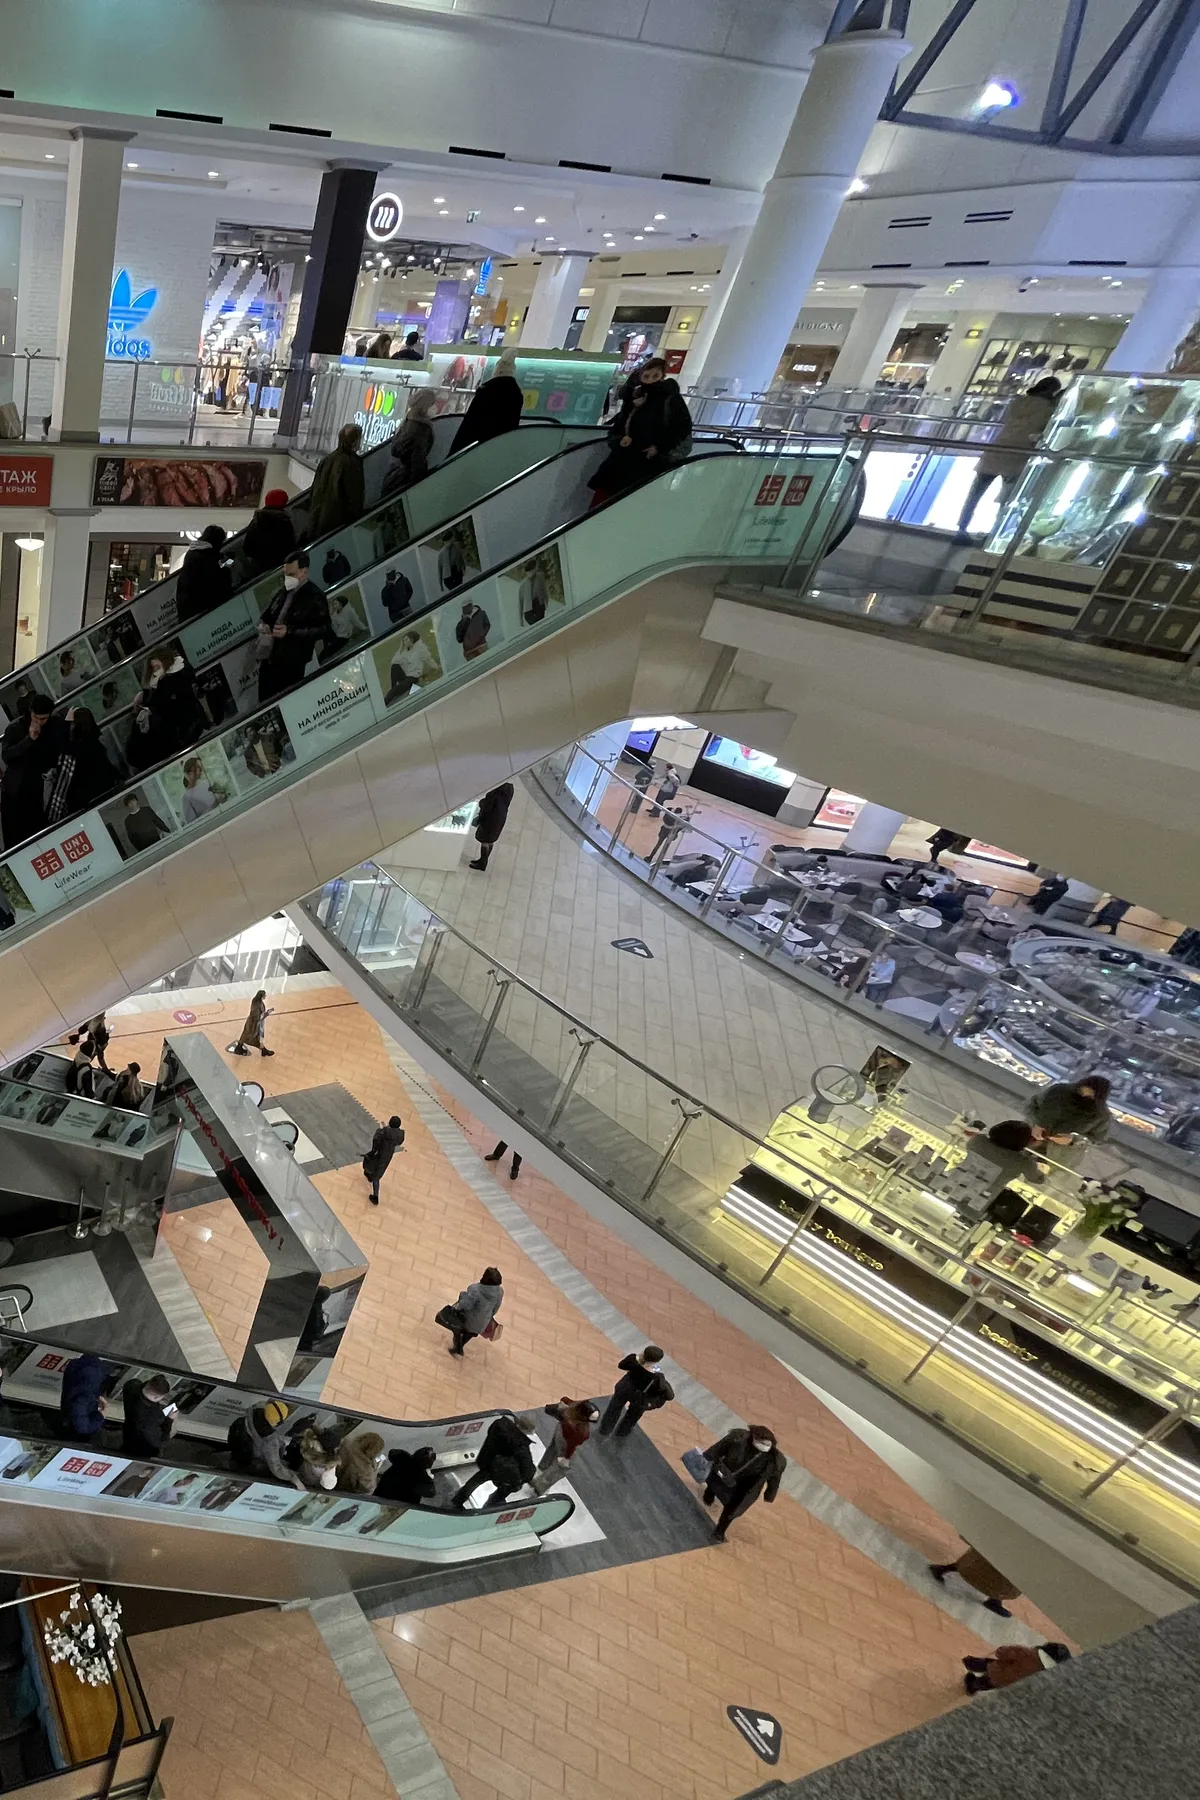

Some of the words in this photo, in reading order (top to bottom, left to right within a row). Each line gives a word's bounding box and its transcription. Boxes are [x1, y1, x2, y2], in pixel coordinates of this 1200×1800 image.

[105, 334, 151, 357] idas
[5, 486, 37, 494] КРЫЛО
[211, 621, 233, 638] МОДА
[297, 717, 312, 729] НА
[312, 682, 368, 720] ИННОВАЦИИ
[317, 687, 345, 706] МОДА
[64, 836, 85, 851] UNI
[69, 843, 90, 860] QLO
[54, 863, 91, 889] LifeWear
[978, 1323, 1039, 1362] beauty
